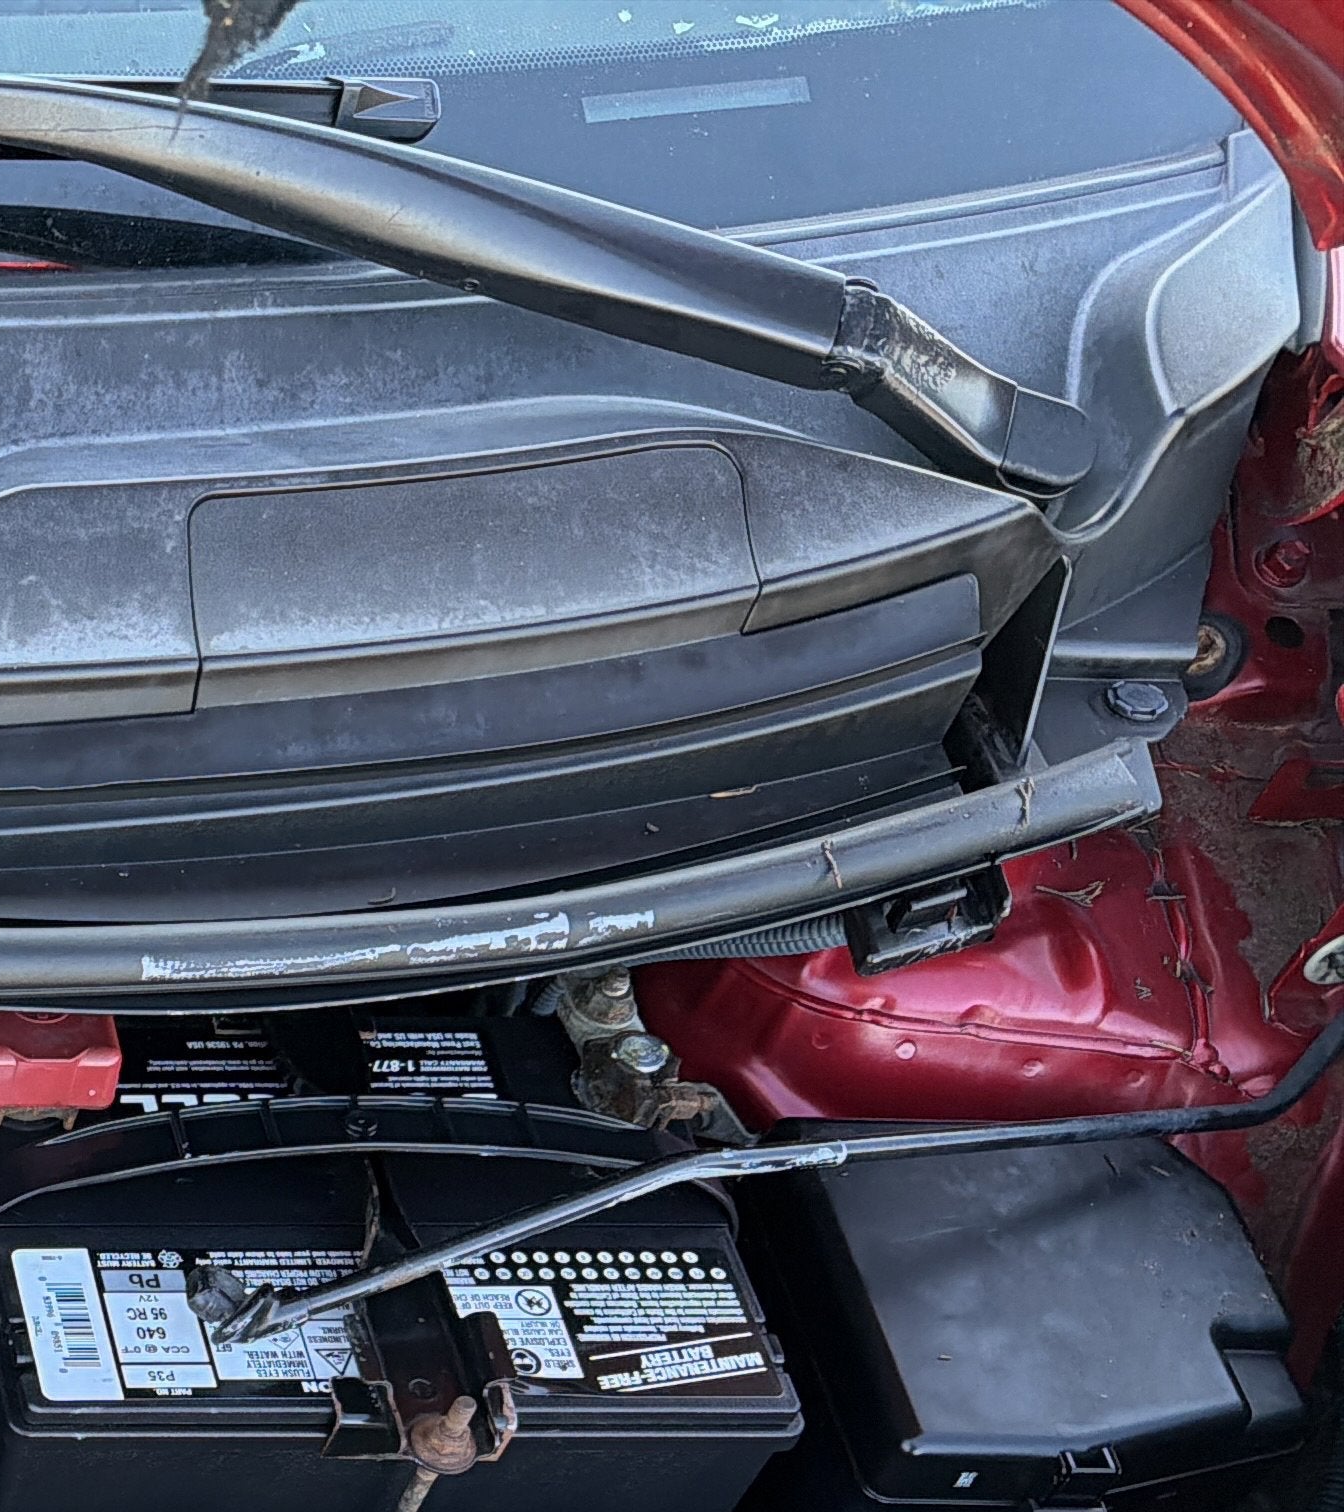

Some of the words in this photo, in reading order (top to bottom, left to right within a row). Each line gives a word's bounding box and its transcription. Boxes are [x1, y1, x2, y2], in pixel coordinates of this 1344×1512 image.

[426, 1032, 444, 1040] USA
[128, 1273, 161, 1289] Pb
[138, 1294, 160, 1303] 12V
[493, 1302, 513, 1310] KEEP
[126, 1307, 148, 1320] RC
[150, 1307, 167, 1320] 95
[136, 1326, 166, 1339] 640
[519, 1337, 568, 1346] EXPLOSIVE
[160, 1345, 190, 1354] CCA
[243, 1350, 278, 1358] WATER.
[281, 1350, 304, 1358] WITH
[640, 1344, 714, 1369] BATTERY
[246, 1360, 308, 1368] IMMEDIATELY
[256, 1369, 280, 1378] EYES
[281, 1369, 311, 1378] FLUSH
[596, 1352, 765, 1390] MAINTENANCE-FREE
[148, 1370, 176, 1382] P35
[152, 1387, 168, 1396] NO.
[168, 1387, 192, 1396] PART
